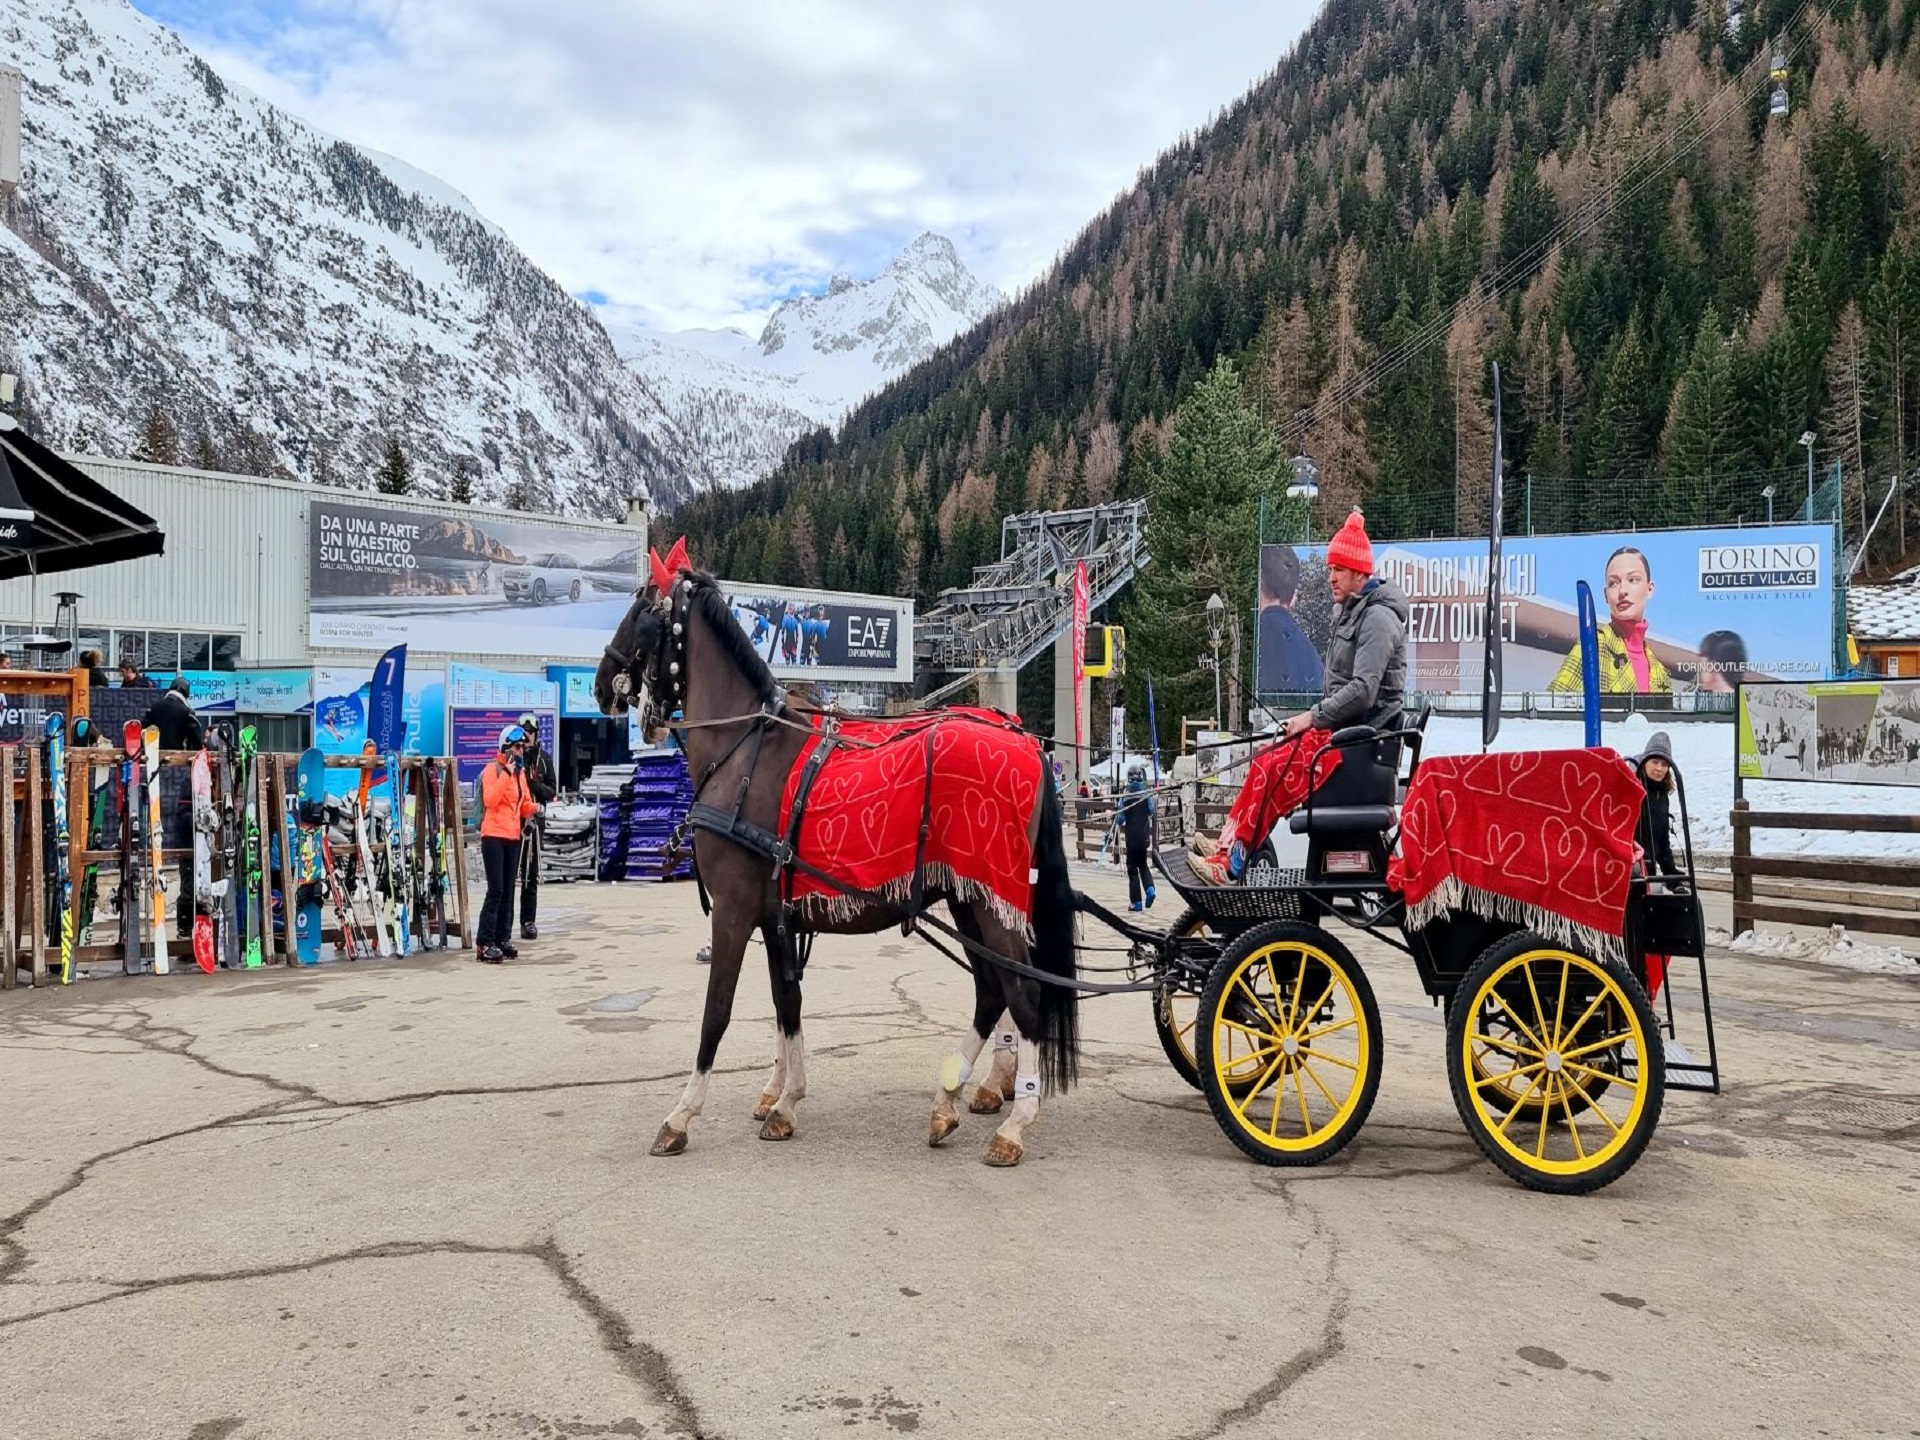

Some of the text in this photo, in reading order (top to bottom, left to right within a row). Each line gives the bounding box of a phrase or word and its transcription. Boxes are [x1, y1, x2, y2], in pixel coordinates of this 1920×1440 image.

[0, 524, 18, 539] ide
[320, 514, 420, 539] DA UNA PARTE
[320, 531, 411, 554] UN MAESTRO
[320, 545, 420, 569] SUL GHIACCIO.
[1702, 545, 1816, 570] TORINO
[1705, 571, 1813, 586] OUTLET VILLAGE
[1744, 592, 1767, 600] REAL
[848, 615, 891, 649] EA7
[1451, 601, 1520, 643] OUTET
[385, 658, 396, 686] 7
[1440, 664, 1452, 677] da
[1676, 661, 1820, 673] TORINOOUTLETVILLAGE.COM
[190, 676, 226, 690] oleggio
